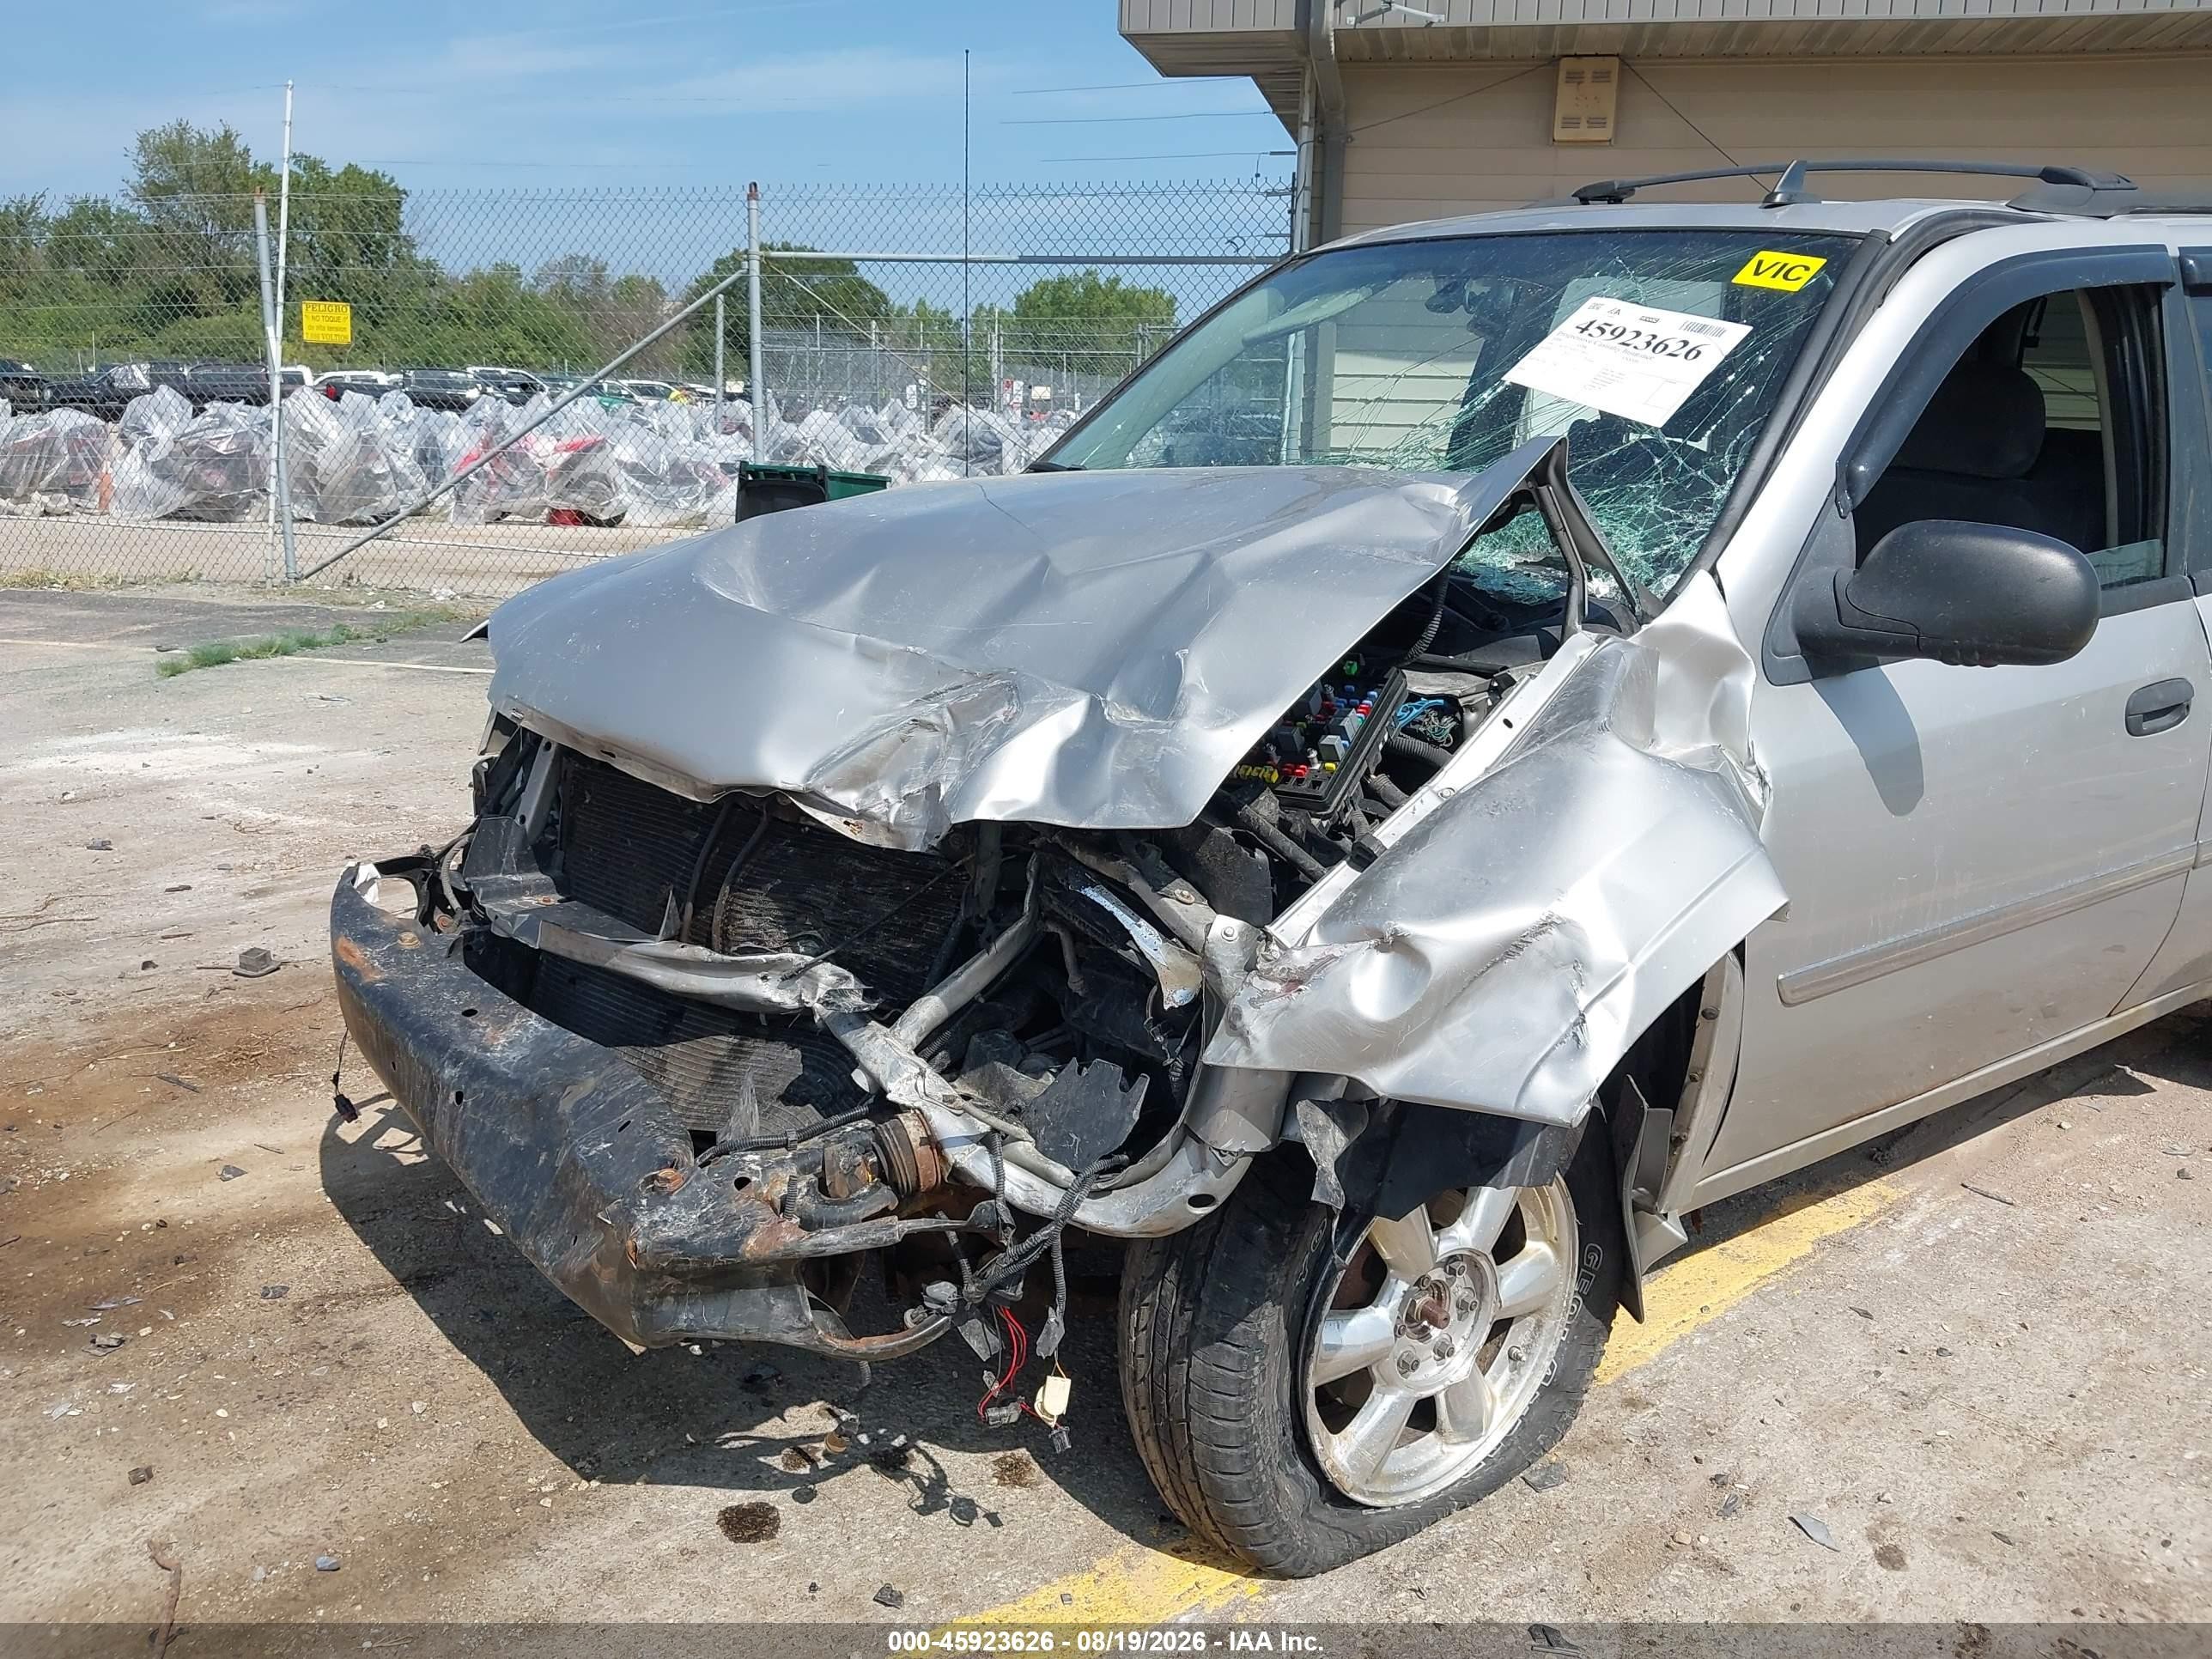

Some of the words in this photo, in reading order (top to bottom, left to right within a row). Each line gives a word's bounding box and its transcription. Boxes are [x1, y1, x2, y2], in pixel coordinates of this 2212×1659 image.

[1753, 259, 1811, 281] VIC
[306, 304, 347, 313] PELIGRO
[1575, 319, 1711, 361] 45923626
